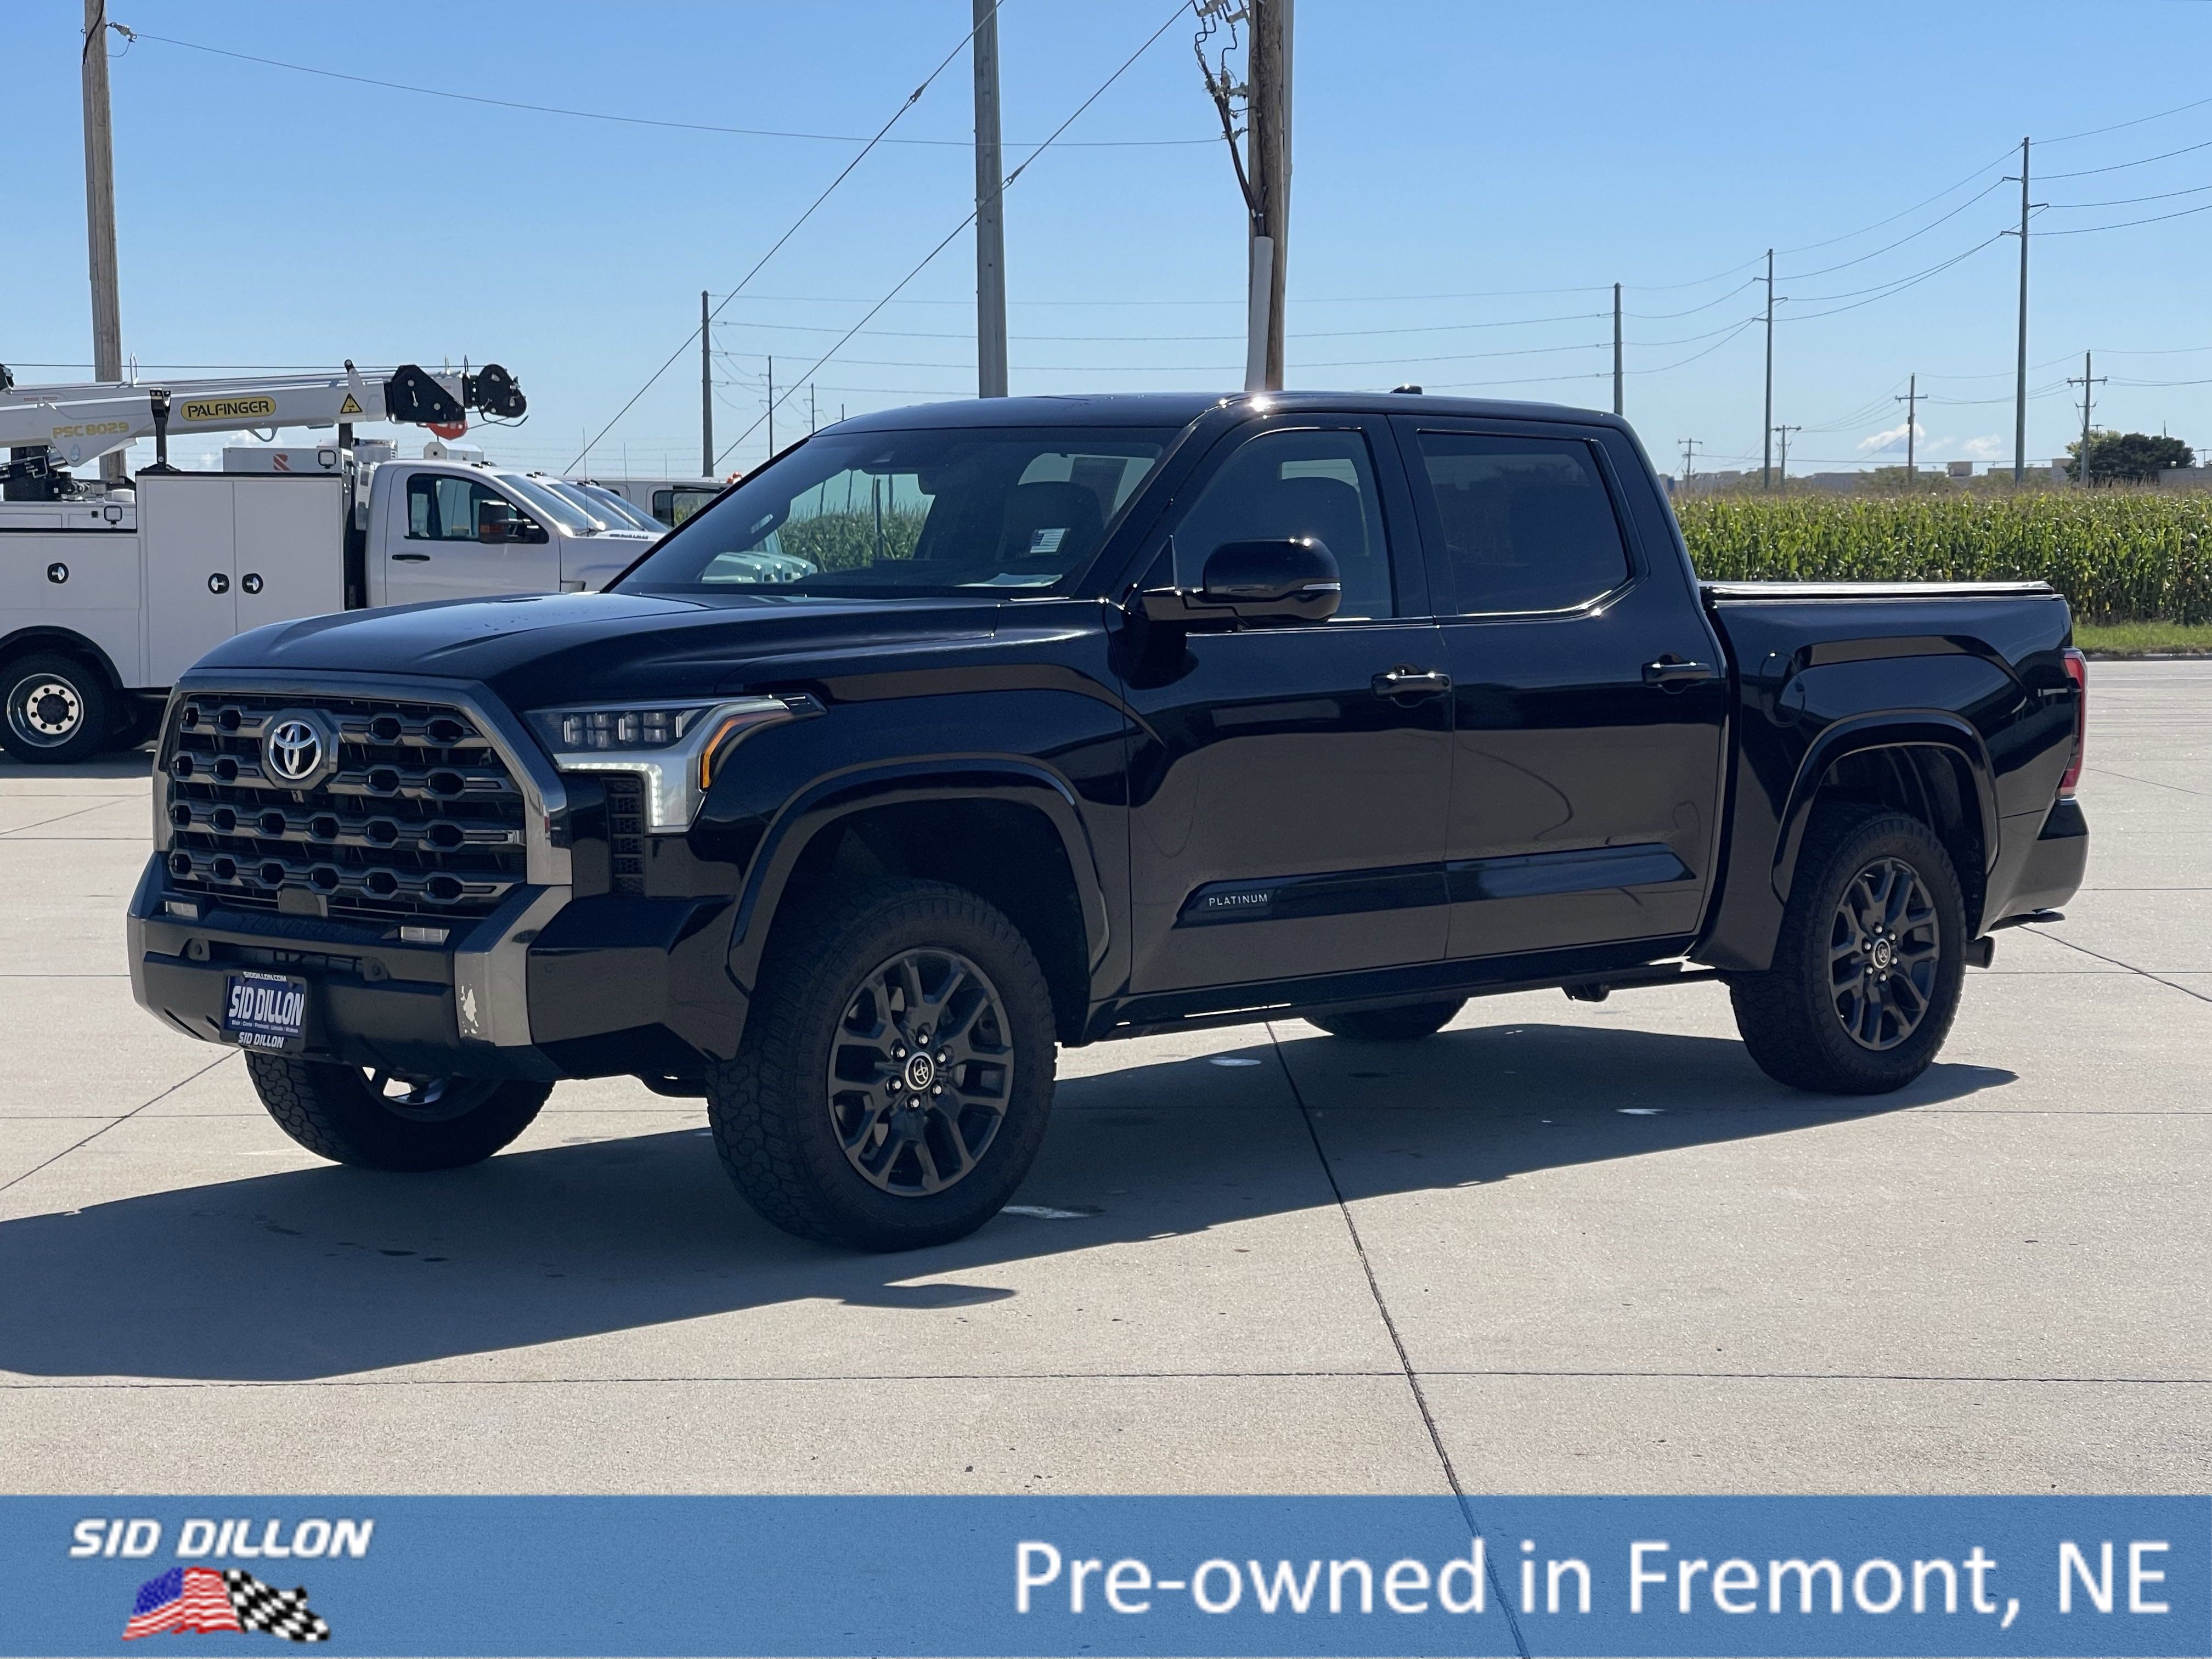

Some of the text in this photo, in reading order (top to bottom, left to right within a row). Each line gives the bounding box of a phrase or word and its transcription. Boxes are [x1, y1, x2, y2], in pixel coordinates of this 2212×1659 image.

[188, 401, 270, 417] PALFINGER
[52, 422, 129, 439] PSC 8029
[1209, 893, 1267, 906] PLATINUM
[242, 971, 287, 983] SIDDILLON.COM
[228, 985, 304, 1026] SID DILLON
[238, 1031, 285, 1048] SID DILLON
